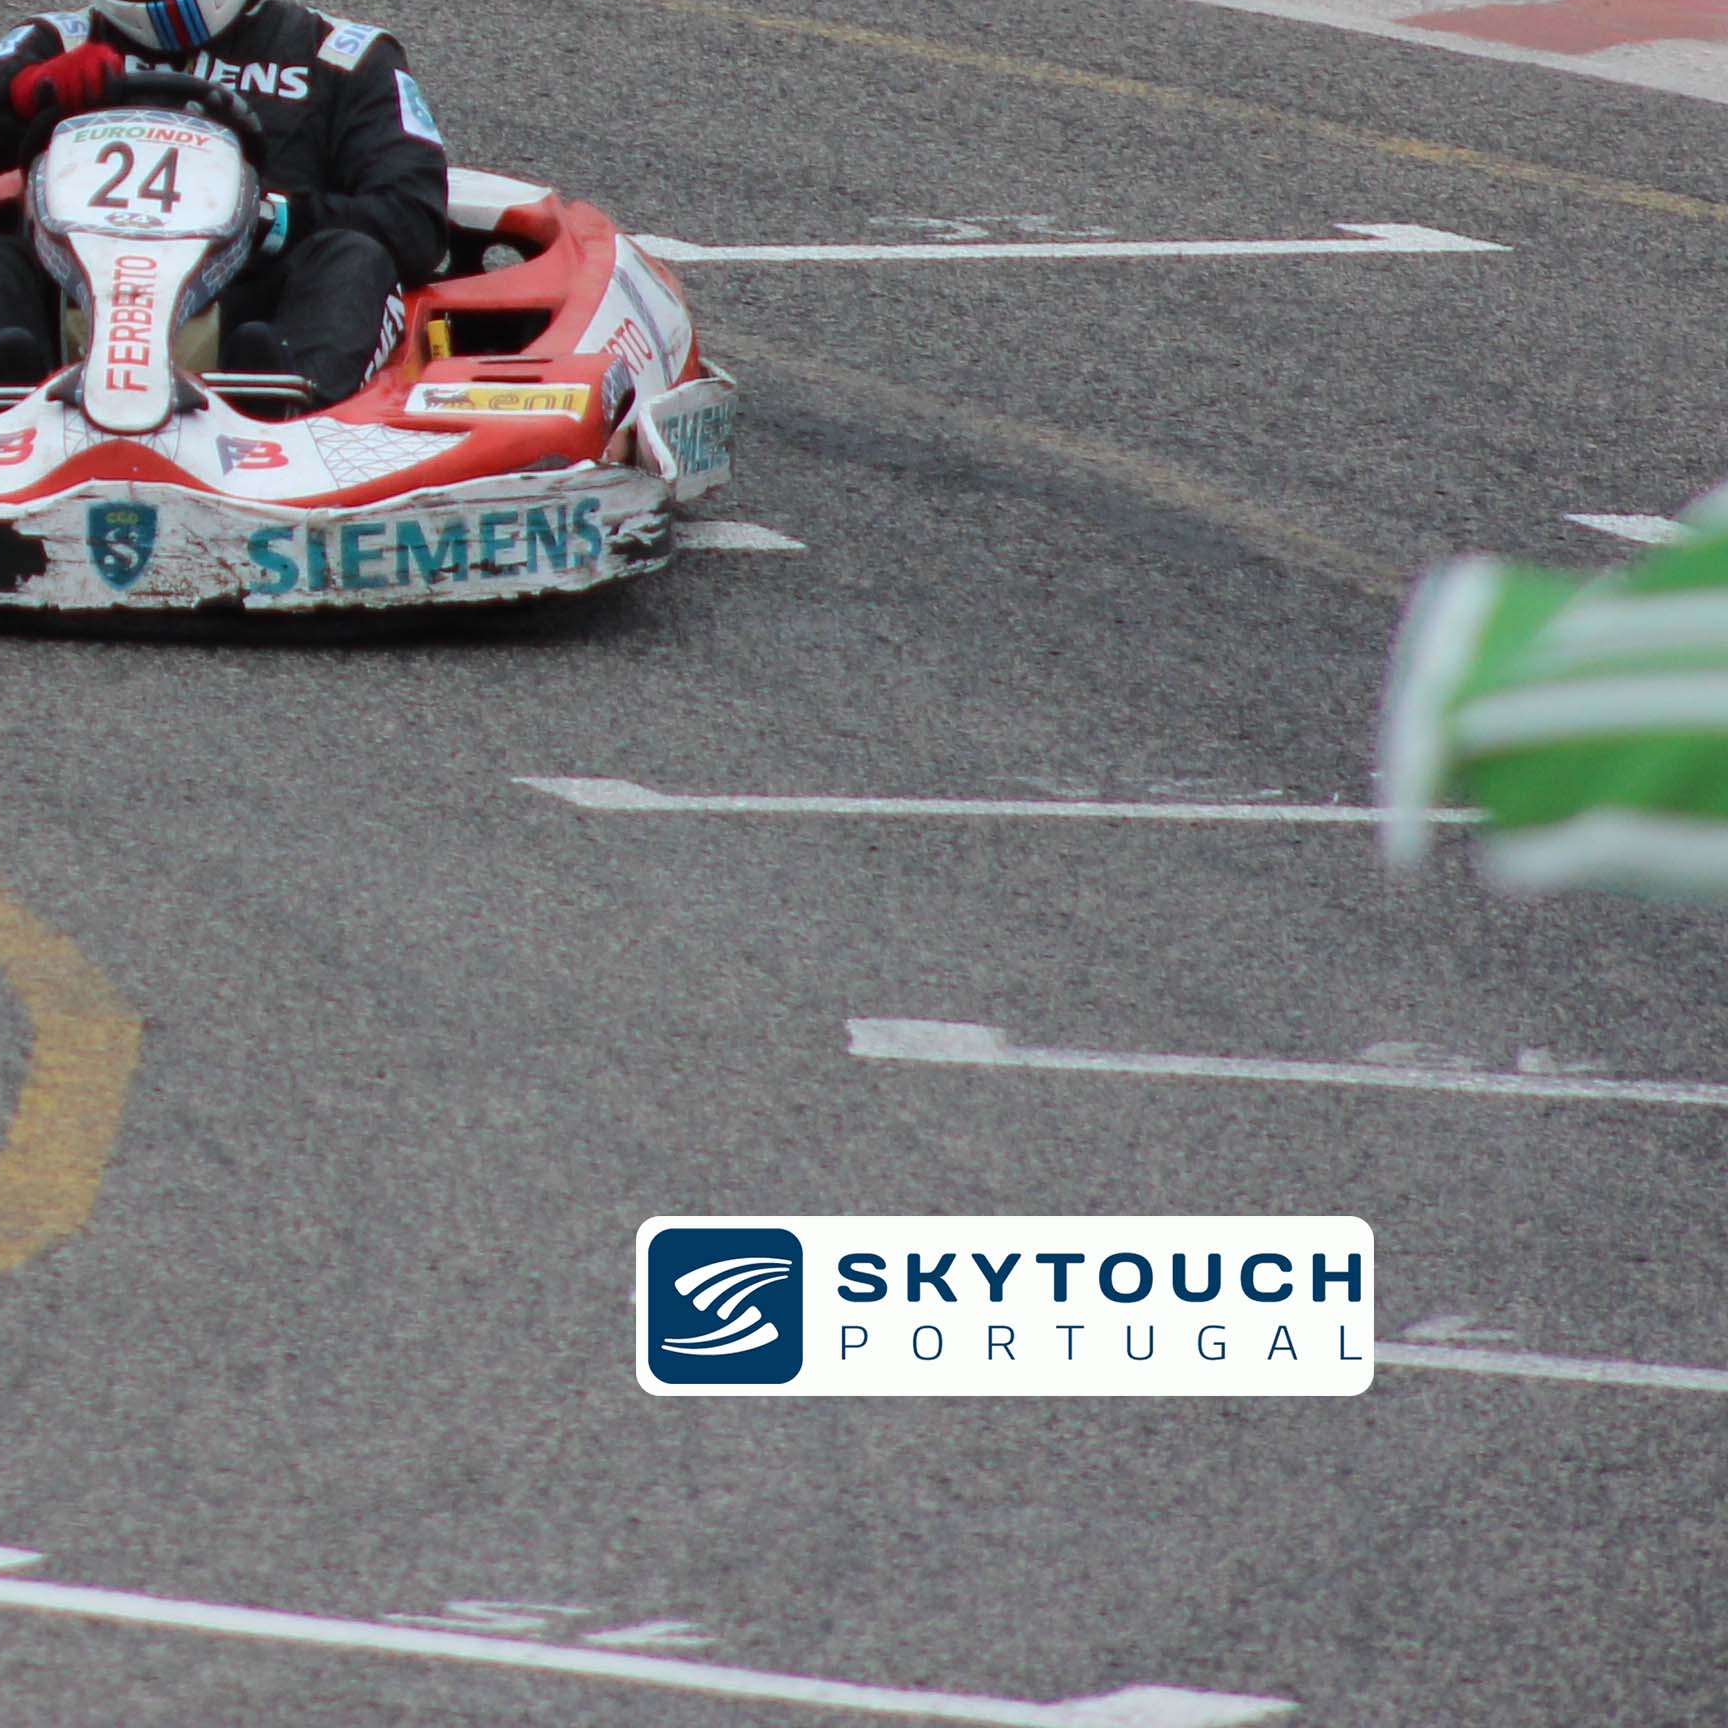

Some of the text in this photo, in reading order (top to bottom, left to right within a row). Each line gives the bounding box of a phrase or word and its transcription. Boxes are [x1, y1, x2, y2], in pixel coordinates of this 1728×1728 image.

[73, 125, 212, 147] EUROINDY
[87, 140, 182, 214] 24
[106, 255, 158, 392] FERBERTO
[246, 497, 604, 595] SIEMENS
